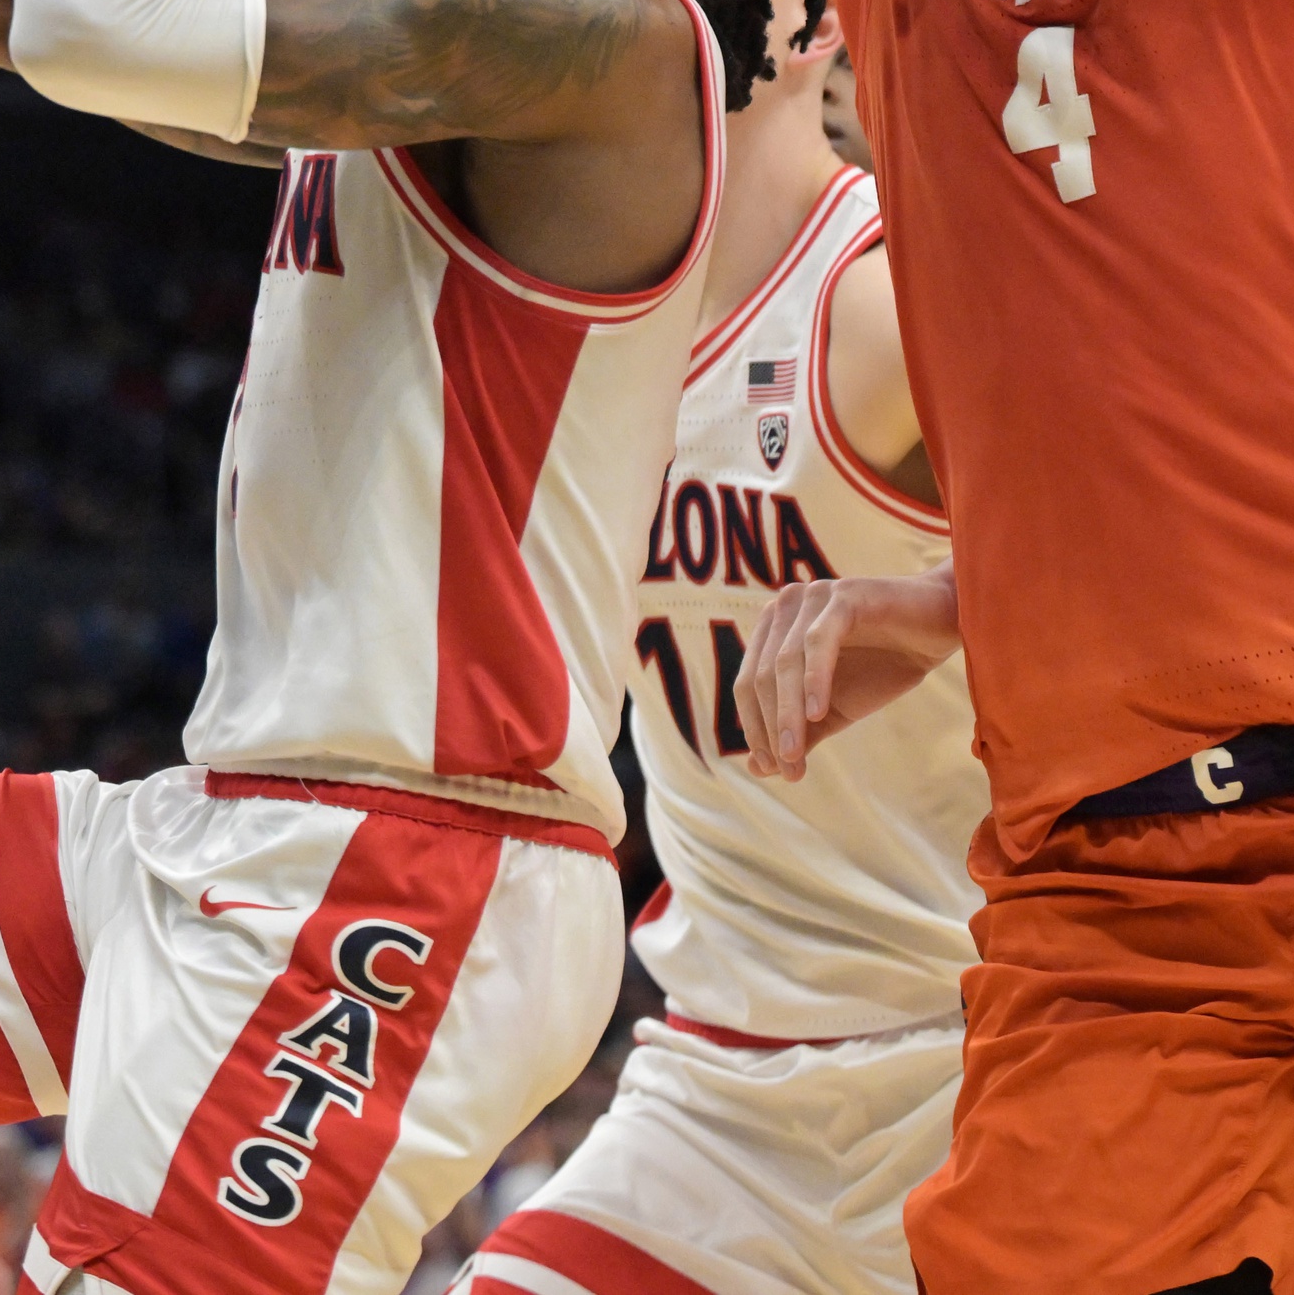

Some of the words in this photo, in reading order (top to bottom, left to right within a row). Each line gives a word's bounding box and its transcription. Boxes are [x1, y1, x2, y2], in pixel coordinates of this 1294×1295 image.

[1002, 26, 1097, 204] 4
[1191, 746, 1244, 805] C
[216, 918, 435, 1227] CATS
